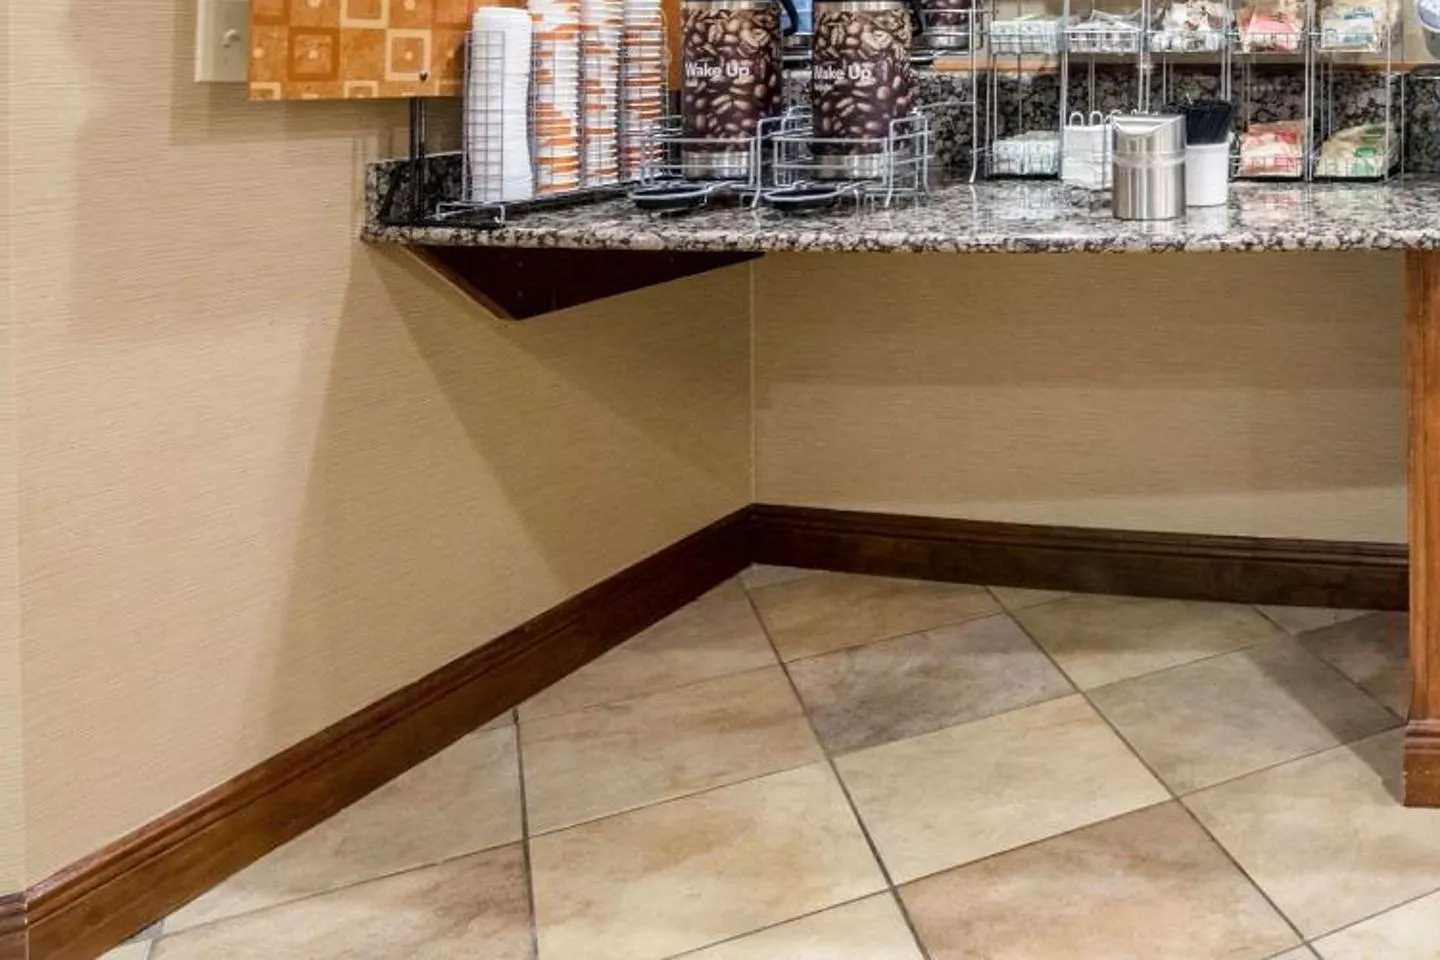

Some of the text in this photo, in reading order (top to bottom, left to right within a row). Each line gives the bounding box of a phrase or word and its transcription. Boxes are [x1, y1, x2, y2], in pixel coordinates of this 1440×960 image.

[685, 61, 750, 83] Wake Up
[848, 64, 872, 83] Up
